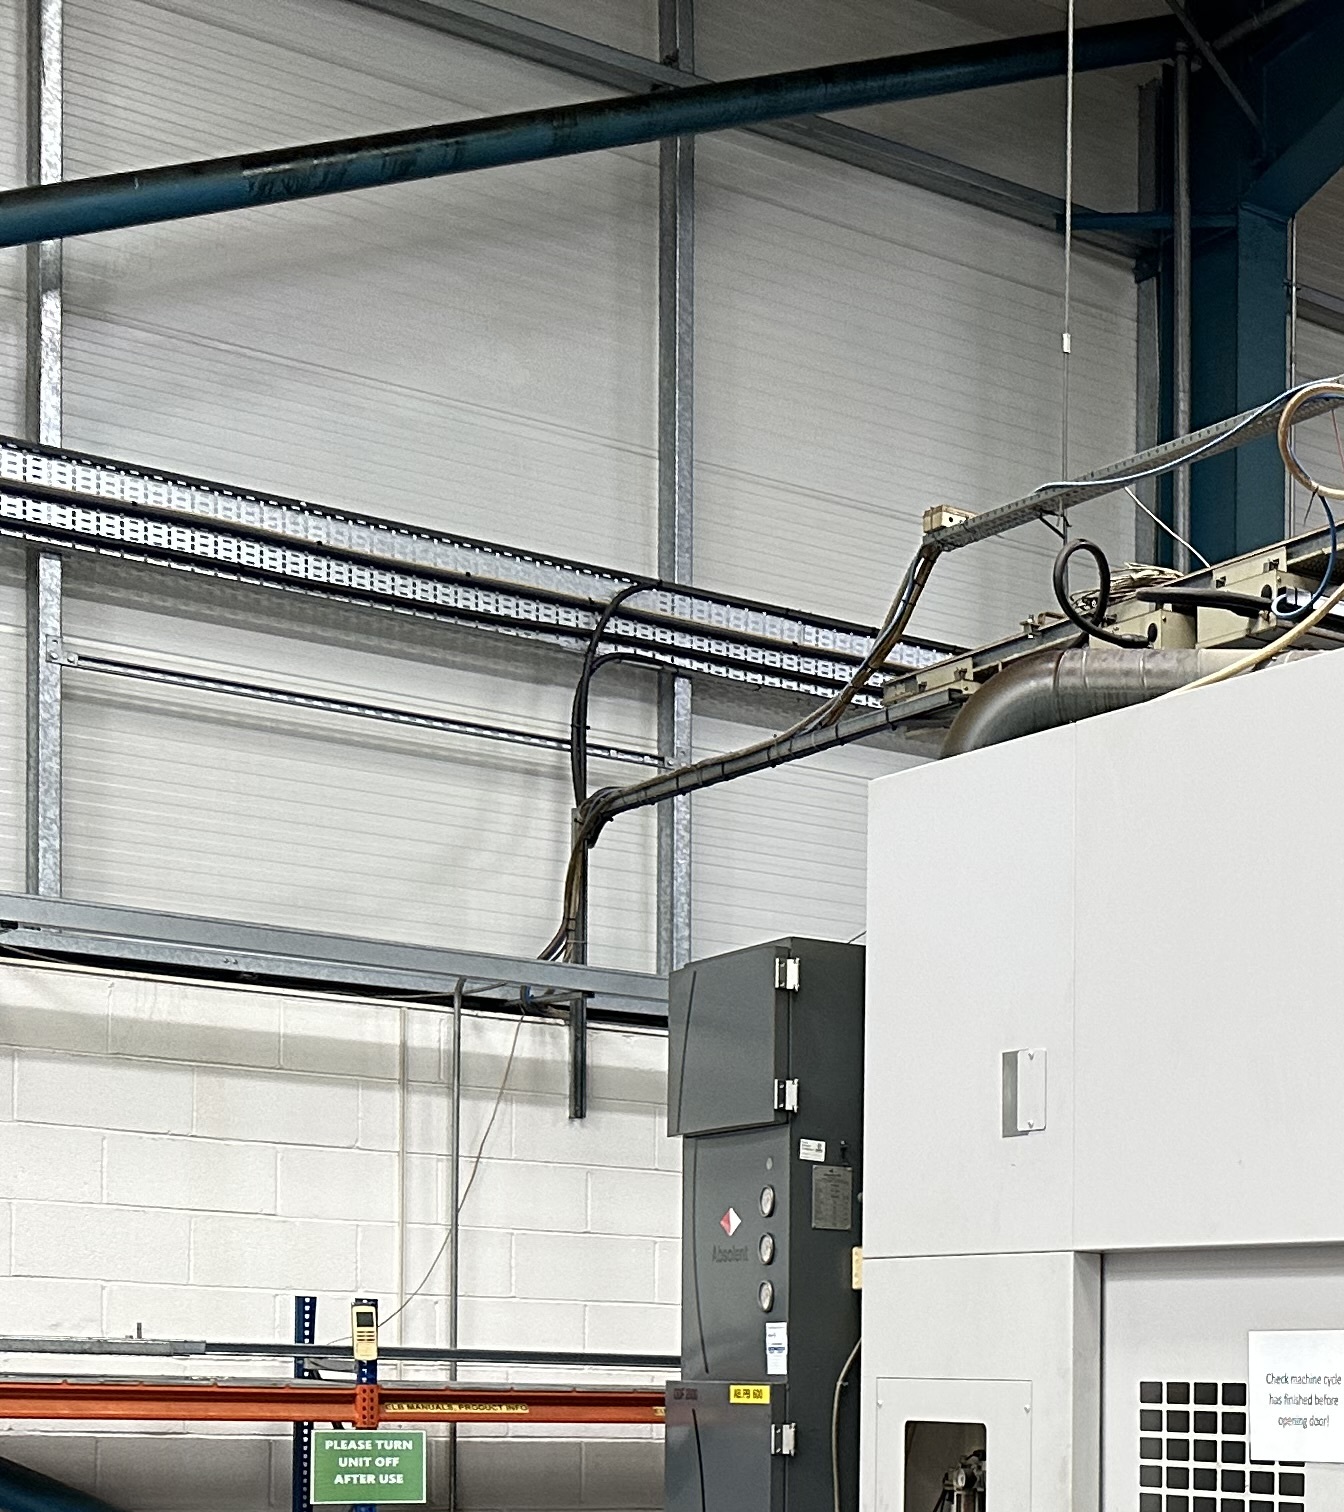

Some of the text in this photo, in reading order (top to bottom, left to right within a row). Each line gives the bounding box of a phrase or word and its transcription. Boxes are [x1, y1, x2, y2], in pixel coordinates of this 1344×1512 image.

[1266, 1373, 1342, 1387] Check machine cycle
[1269, 1394, 1339, 1406] has finished before
[459, 1403, 504, 1411] PRODUCT
[506, 1403, 528, 1411] INFO
[1278, 1415, 1330, 1429] opening door!
[324, 1439, 413, 1450] PLEASE TURN
[338, 1457, 400, 1467] UNIT OFF
[334, 1474, 404, 1484] AFTER USE
